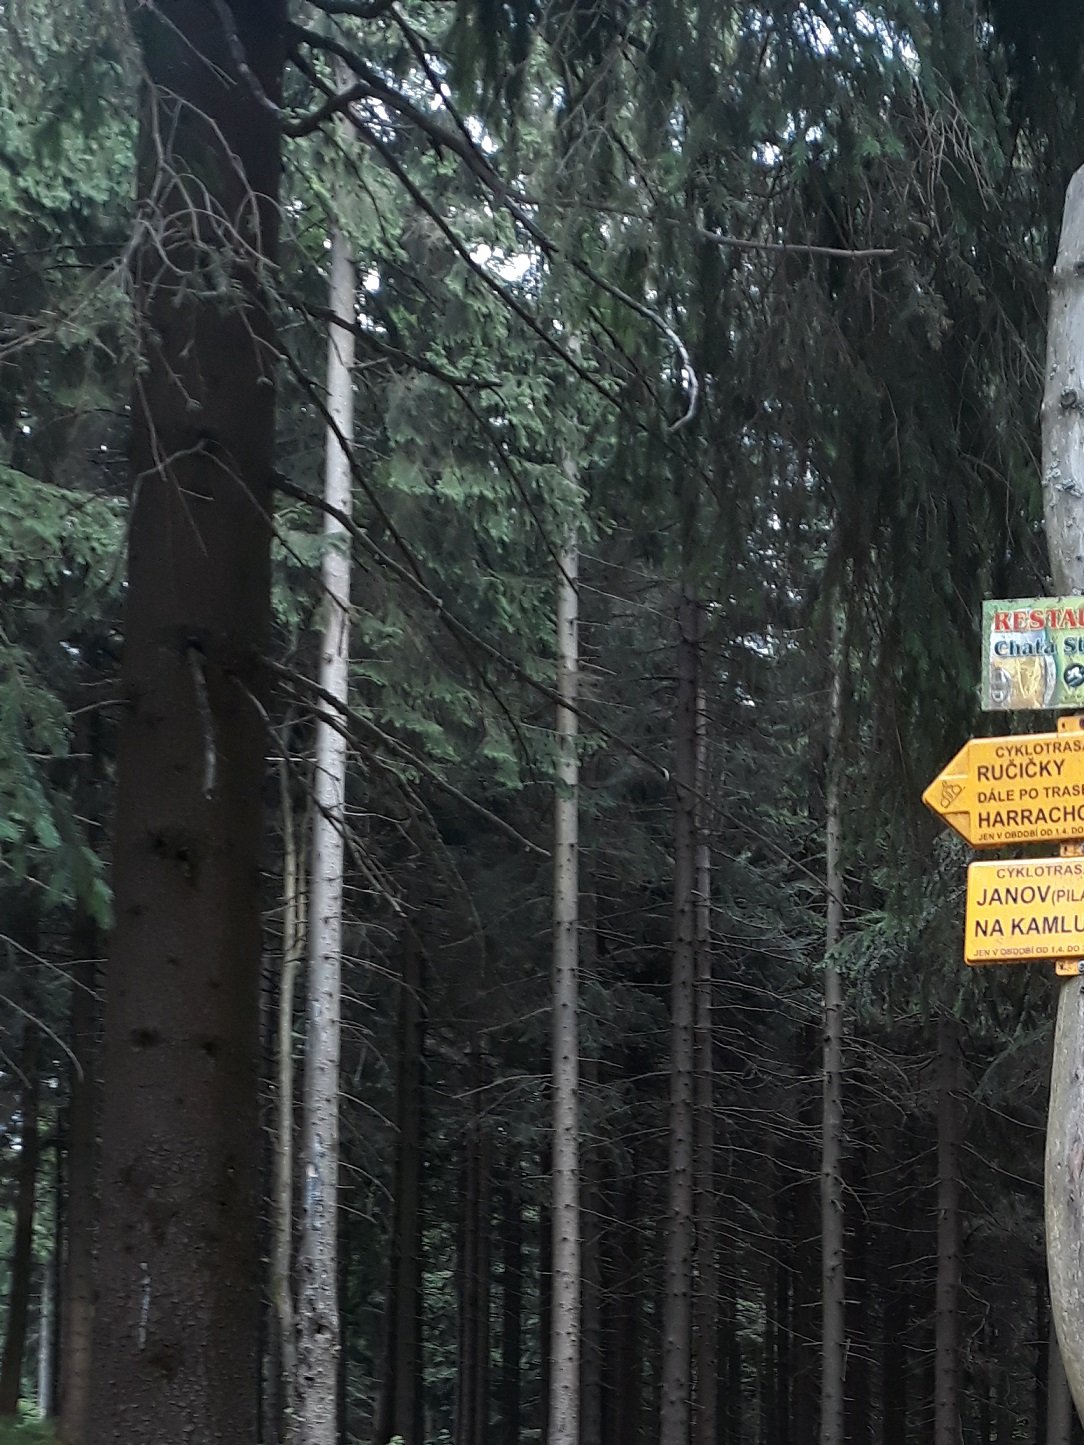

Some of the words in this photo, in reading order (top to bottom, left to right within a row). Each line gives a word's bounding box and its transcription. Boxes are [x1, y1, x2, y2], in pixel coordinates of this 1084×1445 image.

[994, 636, 1058, 656] Chata
[977, 758, 1066, 782] RUČIČKY
[977, 788, 1015, 804] DÁLE
[1019, 788, 1039, 800] PO
[979, 832, 995, 841] JEN
[996, 831, 1003, 840] V
[1040, 828, 1053, 837] OD
[1071, 826, 1084, 834] DO
[975, 918, 1004, 938] NA
[974, 949, 991, 957] JEN
[992, 948, 999, 956] V
[1067, 944, 1080, 952] DO
